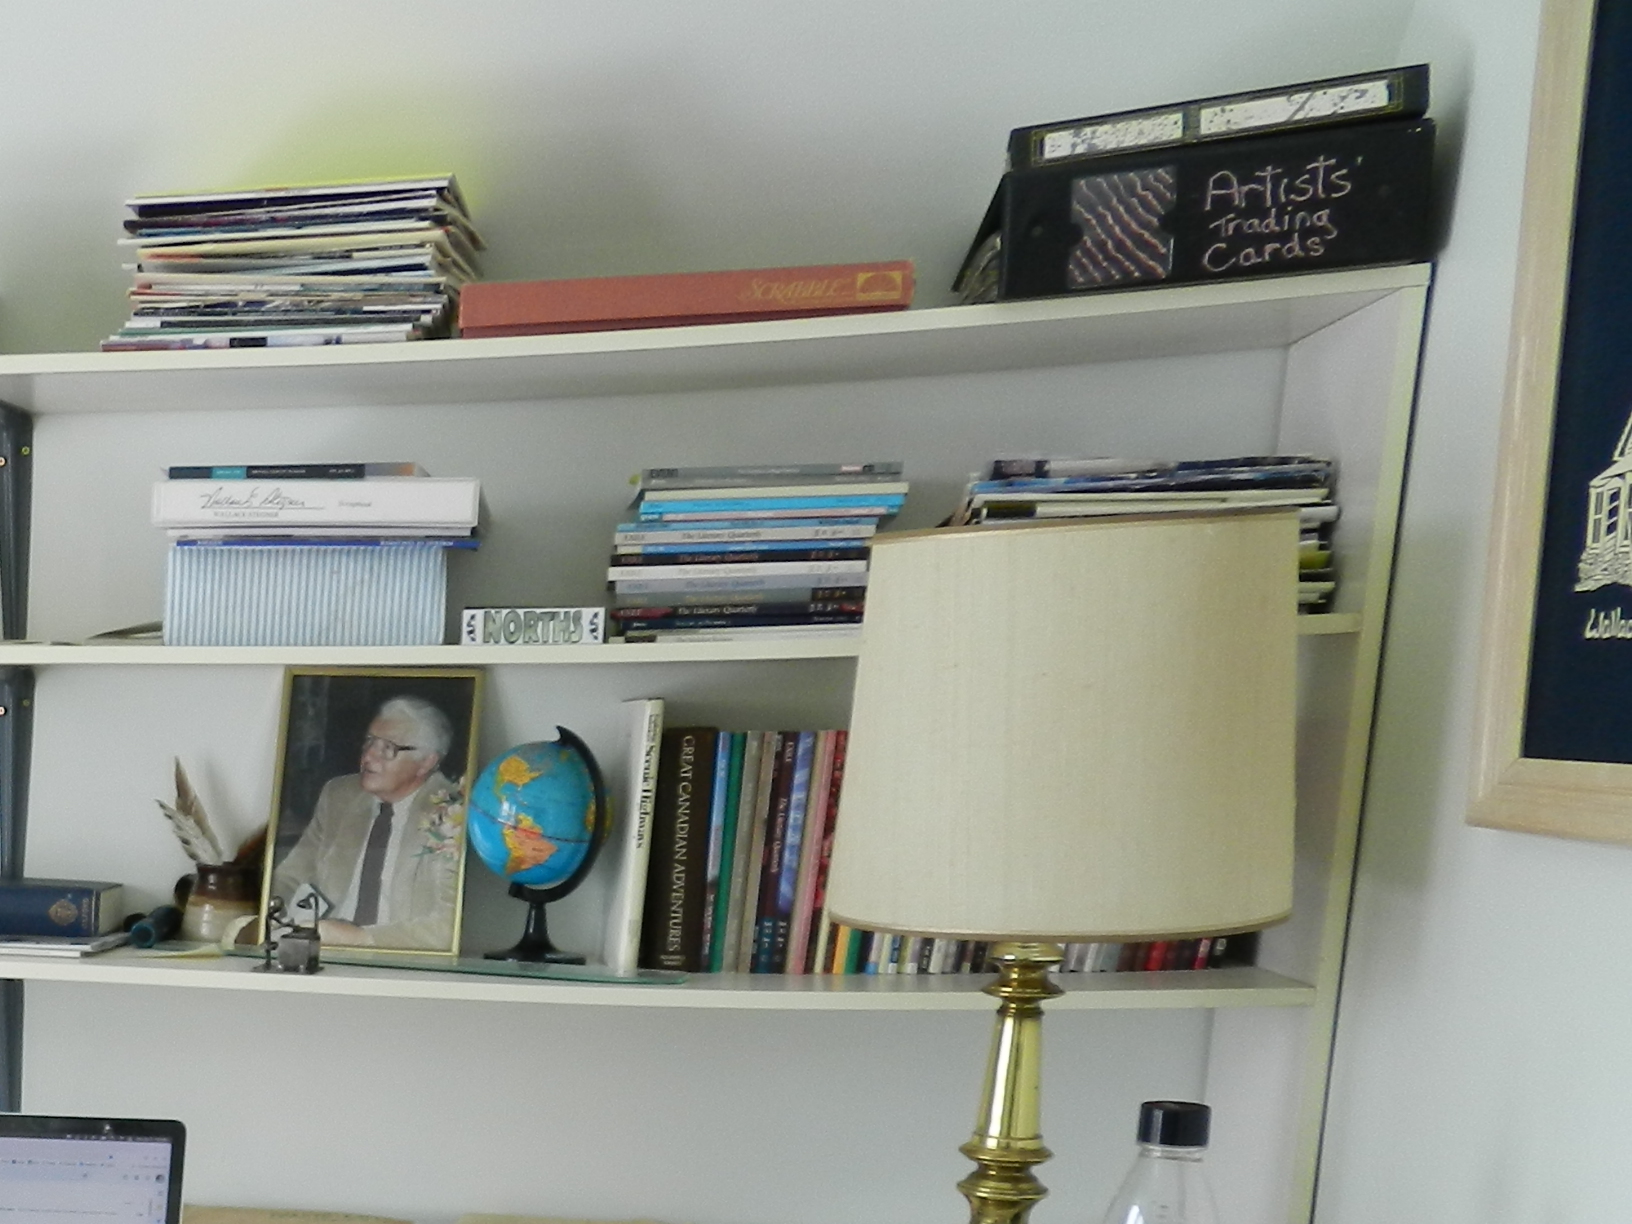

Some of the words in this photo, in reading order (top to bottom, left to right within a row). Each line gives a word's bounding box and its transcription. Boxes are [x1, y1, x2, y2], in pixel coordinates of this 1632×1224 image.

[1204, 154, 1363, 212] Artists'
[1209, 206, 1338, 240] Trading
[1201, 234, 1325, 273] Cards
[749, 278, 842, 302] SCRABBLE
[483, 609, 584, 644] NORTHS
[679, 735, 696, 780] GREAT
[636, 787, 653, 850] Highways
[673, 786, 693, 861] CANADIAN
[667, 864, 687, 953] ADVENTURES
